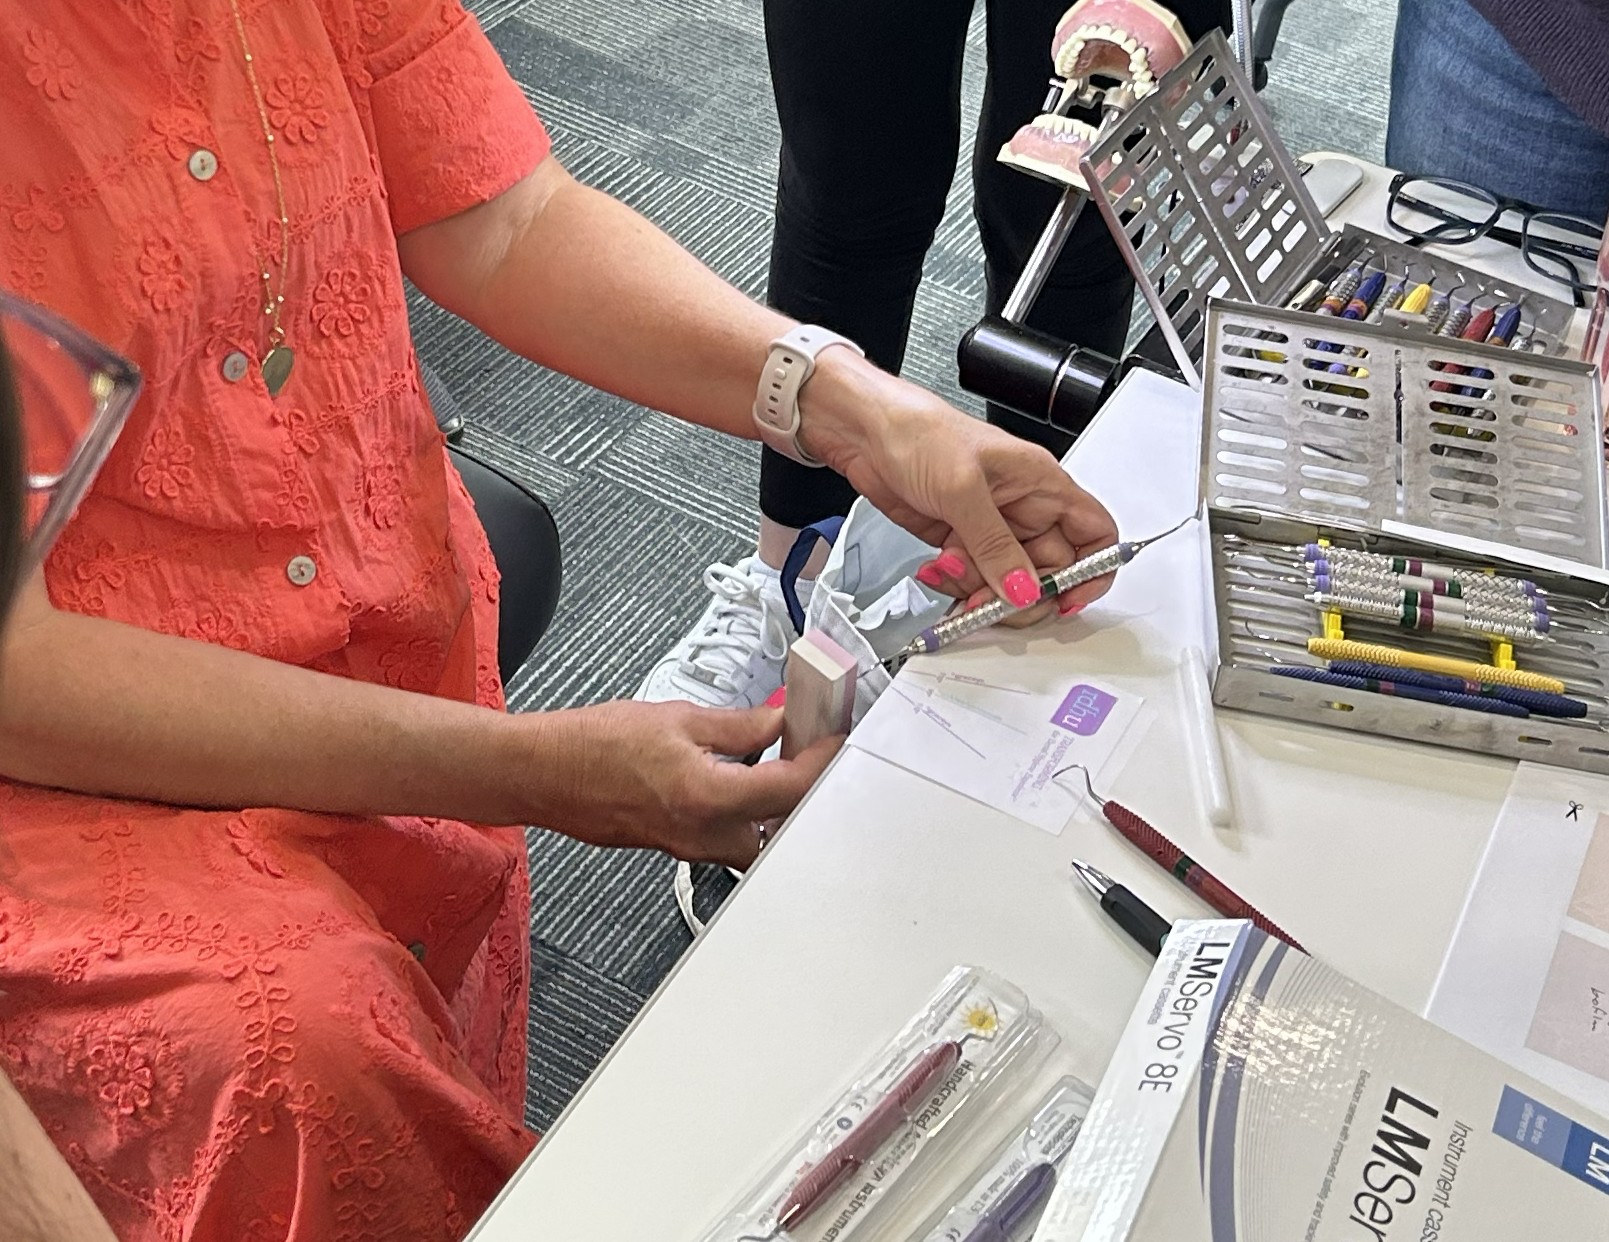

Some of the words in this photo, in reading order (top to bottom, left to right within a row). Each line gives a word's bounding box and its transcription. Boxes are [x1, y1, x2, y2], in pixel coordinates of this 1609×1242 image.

[1062, 688, 1100, 728] rdhu
[915, 1059, 974, 1131] Handcrafted
[1138, 1063, 1178, 1093] 8E
[1530, 1128, 1543, 1145] the
[1431, 1120, 1474, 1209] Instrument
[1585, 1141, 1609, 1187] LM
[1312, 1200, 1325, 1219] and
